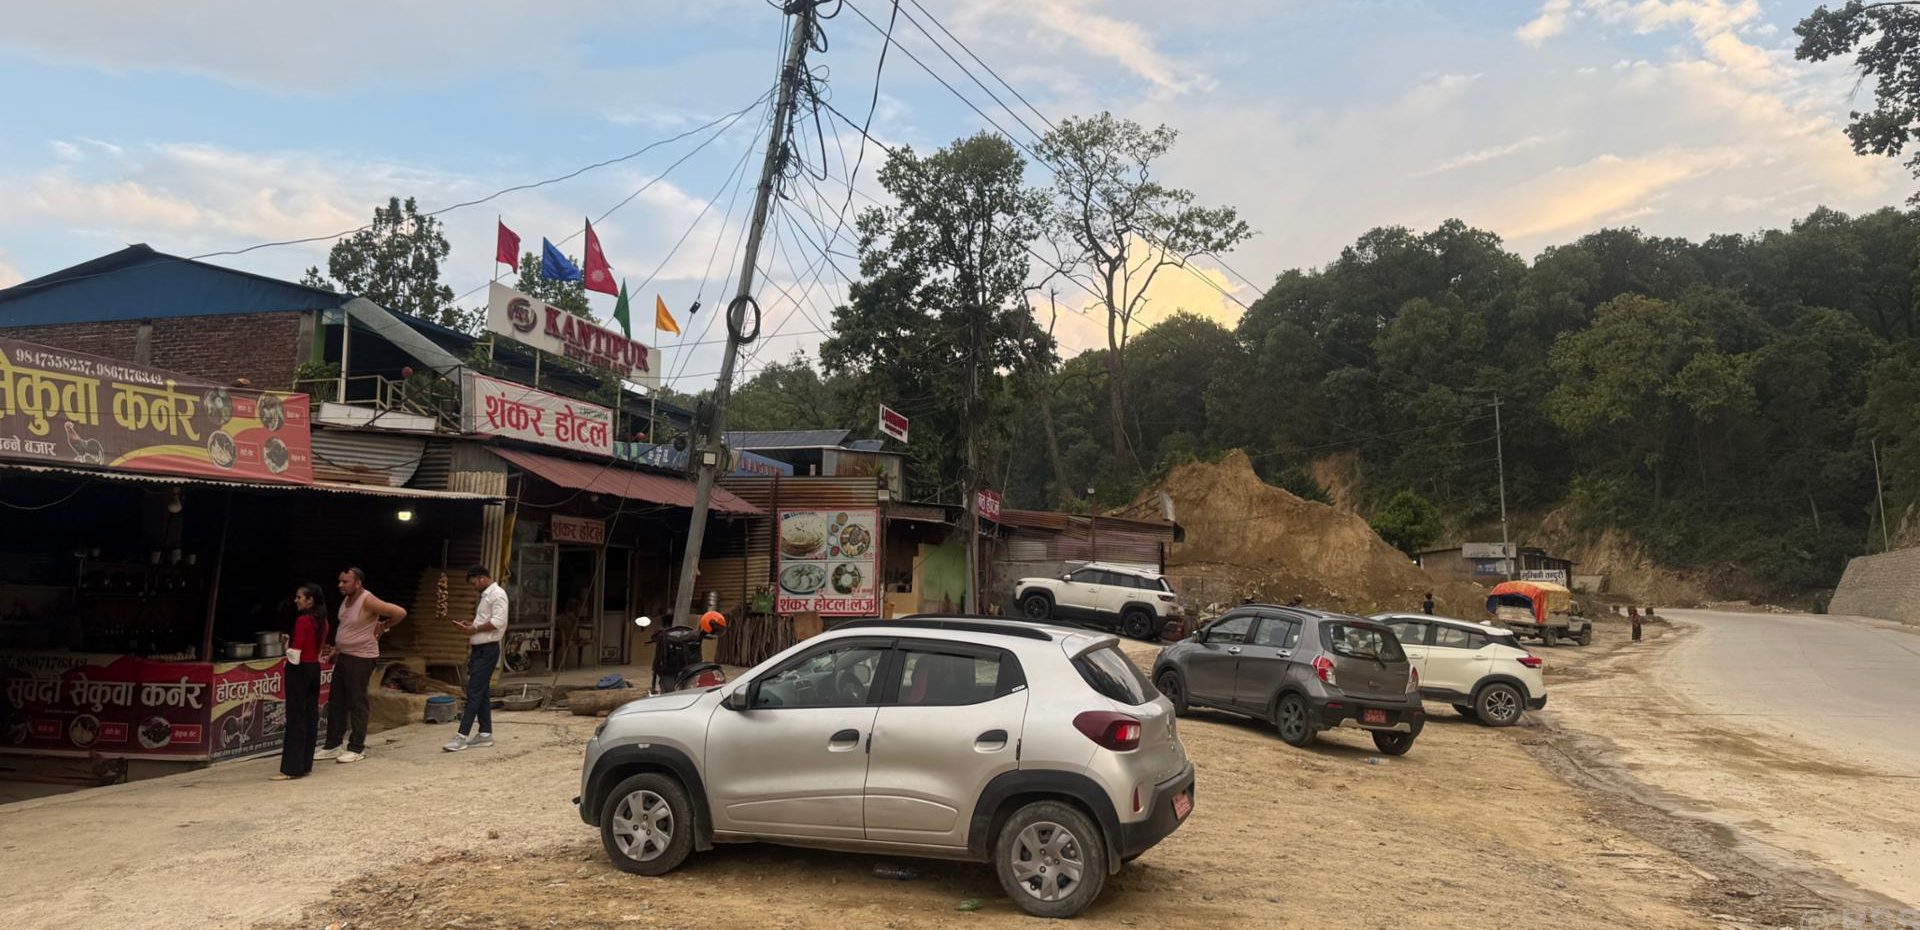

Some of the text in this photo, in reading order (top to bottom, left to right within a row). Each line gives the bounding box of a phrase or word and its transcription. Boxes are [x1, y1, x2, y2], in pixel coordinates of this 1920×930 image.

[544, 305, 649, 372] KANTIPUR
[112, 379, 200, 441] कर्नर
[485, 392, 608, 447] शंकर होटल
[24, 440, 56, 457] बजार
[780, 596, 811, 611] शंकर
[70, 672, 136, 712] सेकुवा
[141, 676, 207, 710] कर्नर
[216, 672, 281, 703] होटल सुवेदी
